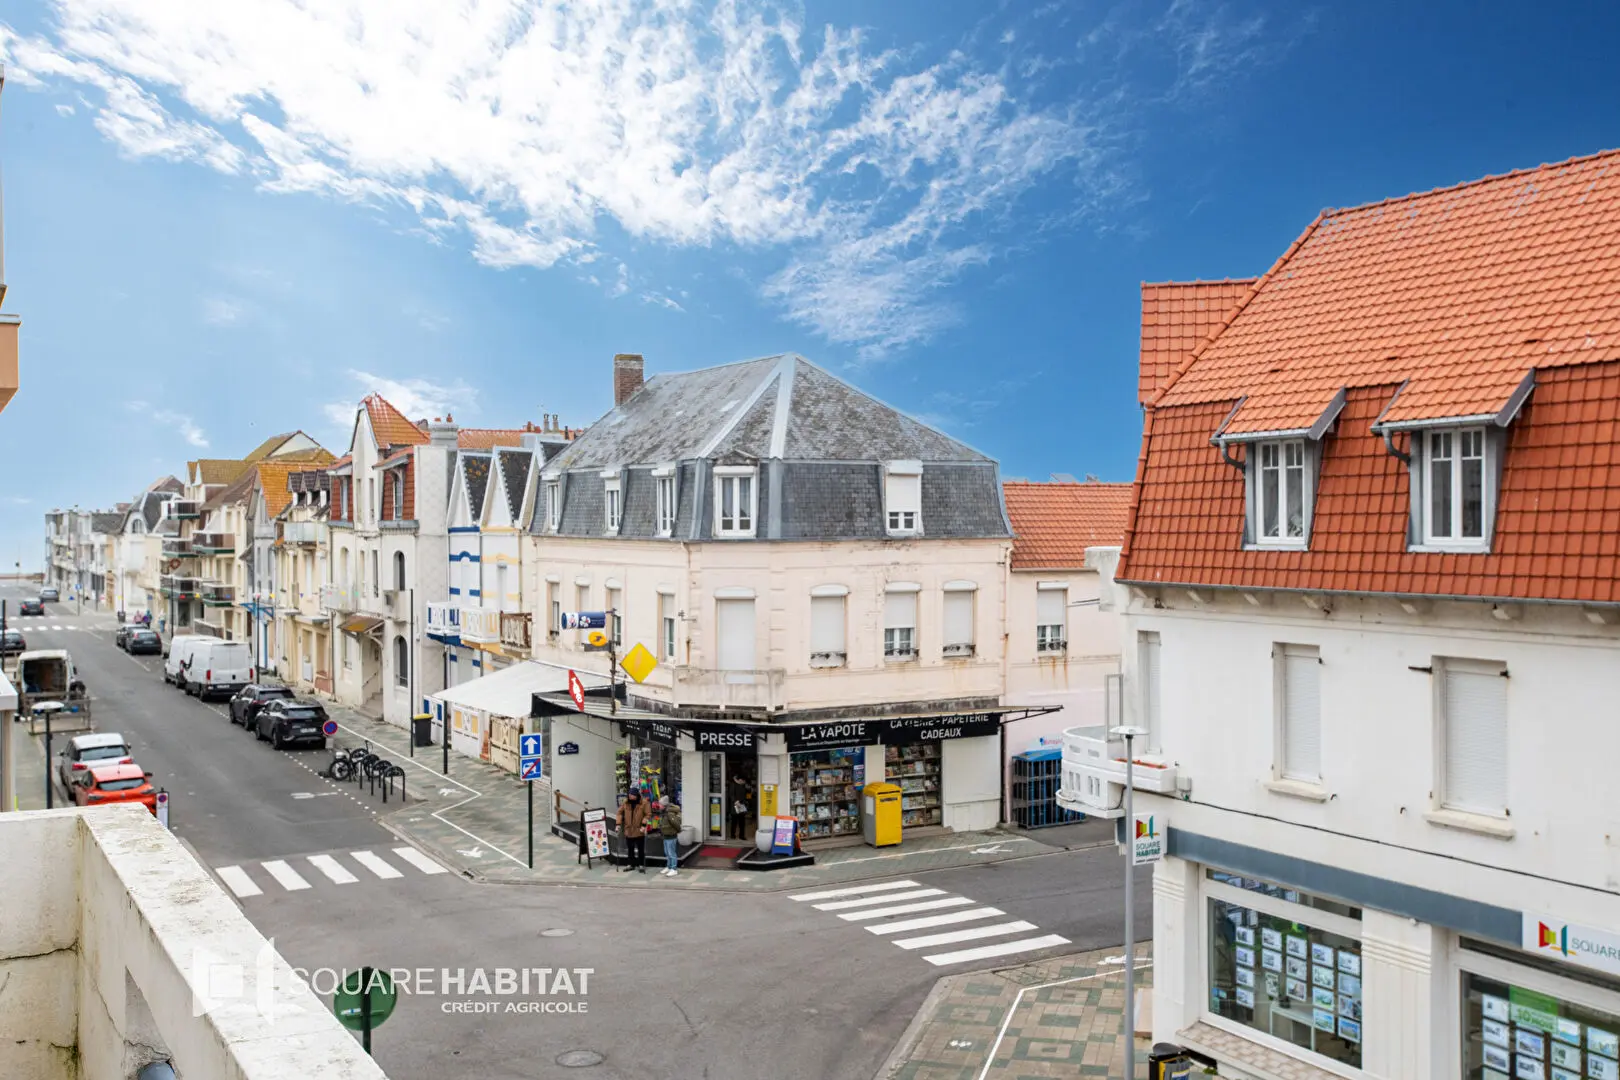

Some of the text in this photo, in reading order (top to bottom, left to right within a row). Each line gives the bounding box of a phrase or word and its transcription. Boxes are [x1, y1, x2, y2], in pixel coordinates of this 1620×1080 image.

[942, 715, 989, 725] PAPETERIE
[801, 723, 866, 740] LA VAPOTE
[920, 728, 962, 740] CADEAUX
[700, 732, 752, 746] PRESSE
[1136, 841, 1161, 850] SQUARE
